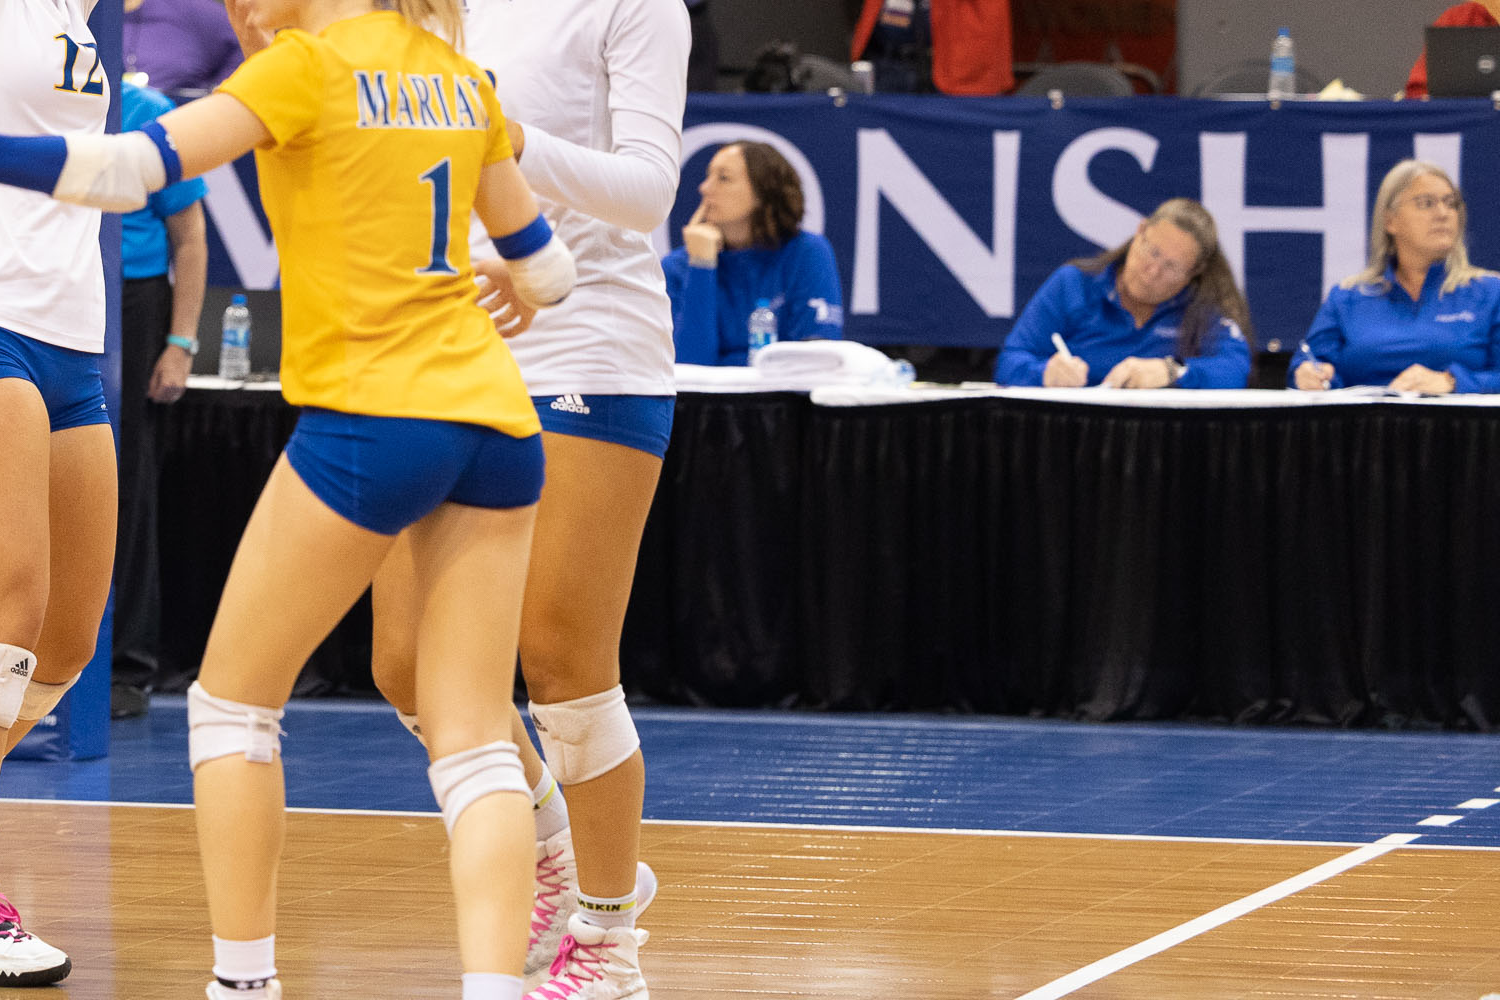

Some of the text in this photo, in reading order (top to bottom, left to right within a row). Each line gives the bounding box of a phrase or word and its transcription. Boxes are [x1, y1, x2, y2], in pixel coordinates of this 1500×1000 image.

[53, 32, 104, 97] 12
[414, 157, 460, 277] 1
[550, 401, 591, 415] adidas
